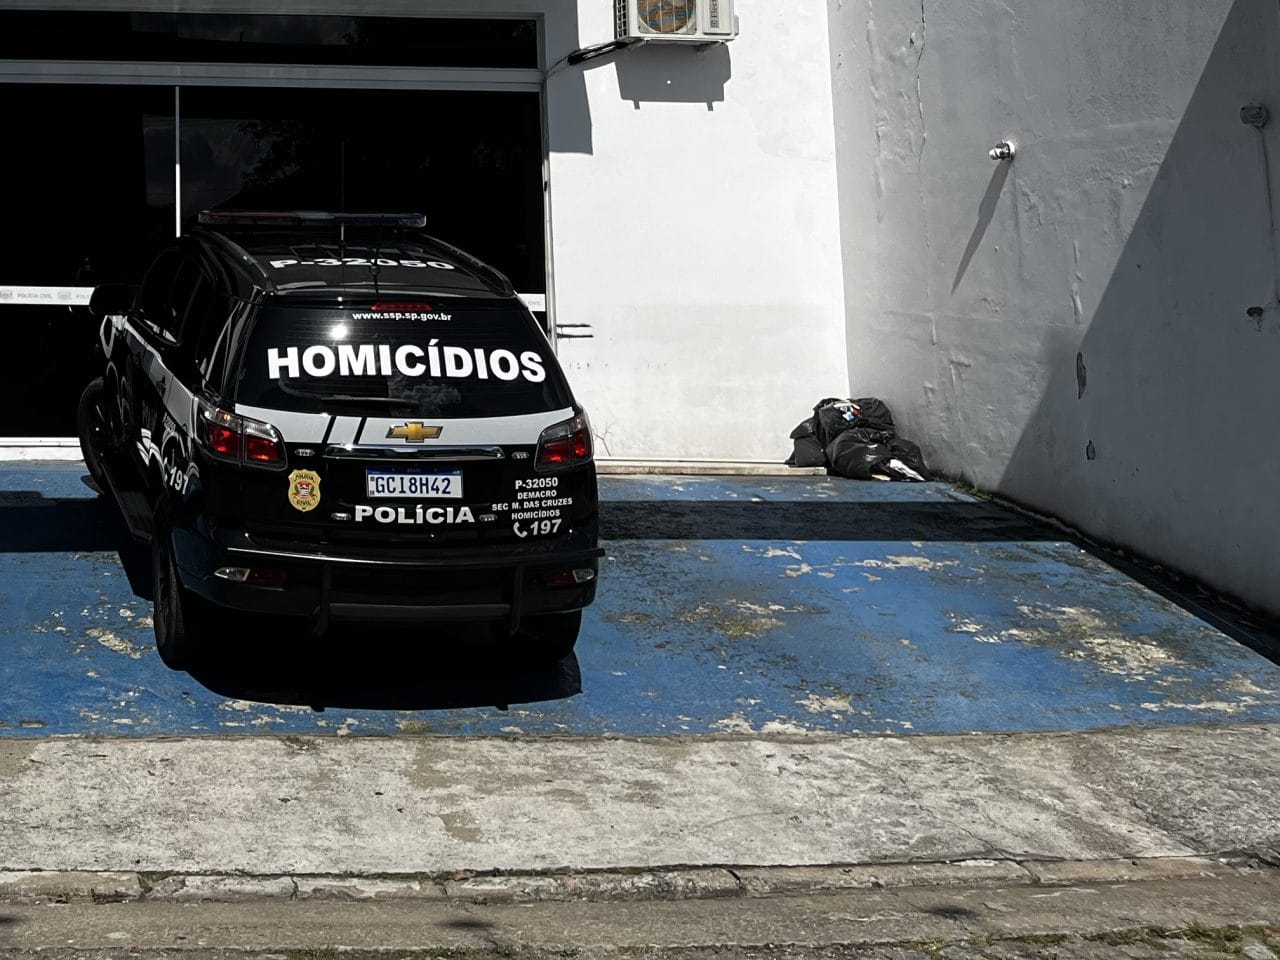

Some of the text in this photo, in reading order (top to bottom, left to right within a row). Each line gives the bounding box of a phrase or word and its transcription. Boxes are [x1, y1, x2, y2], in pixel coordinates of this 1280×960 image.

[270, 258, 455, 270] P-32050
[352, 312, 452, 322] www.ssp.sp.gov.br
[268, 339, 546, 383] HOMICÍDIOS
[170, 466, 189, 495] 197
[375, 476, 451, 494] GCI8H42
[515, 477, 558, 489] P-32050
[517, 490, 557, 500] DEMACRO
[491, 503, 508, 511] SEC
[542, 497, 573, 507] CRUZES
[355, 504, 475, 524] POLÍCIA
[511, 509, 560, 520] HOMICÍDIOS
[530, 518, 562, 536] 197
